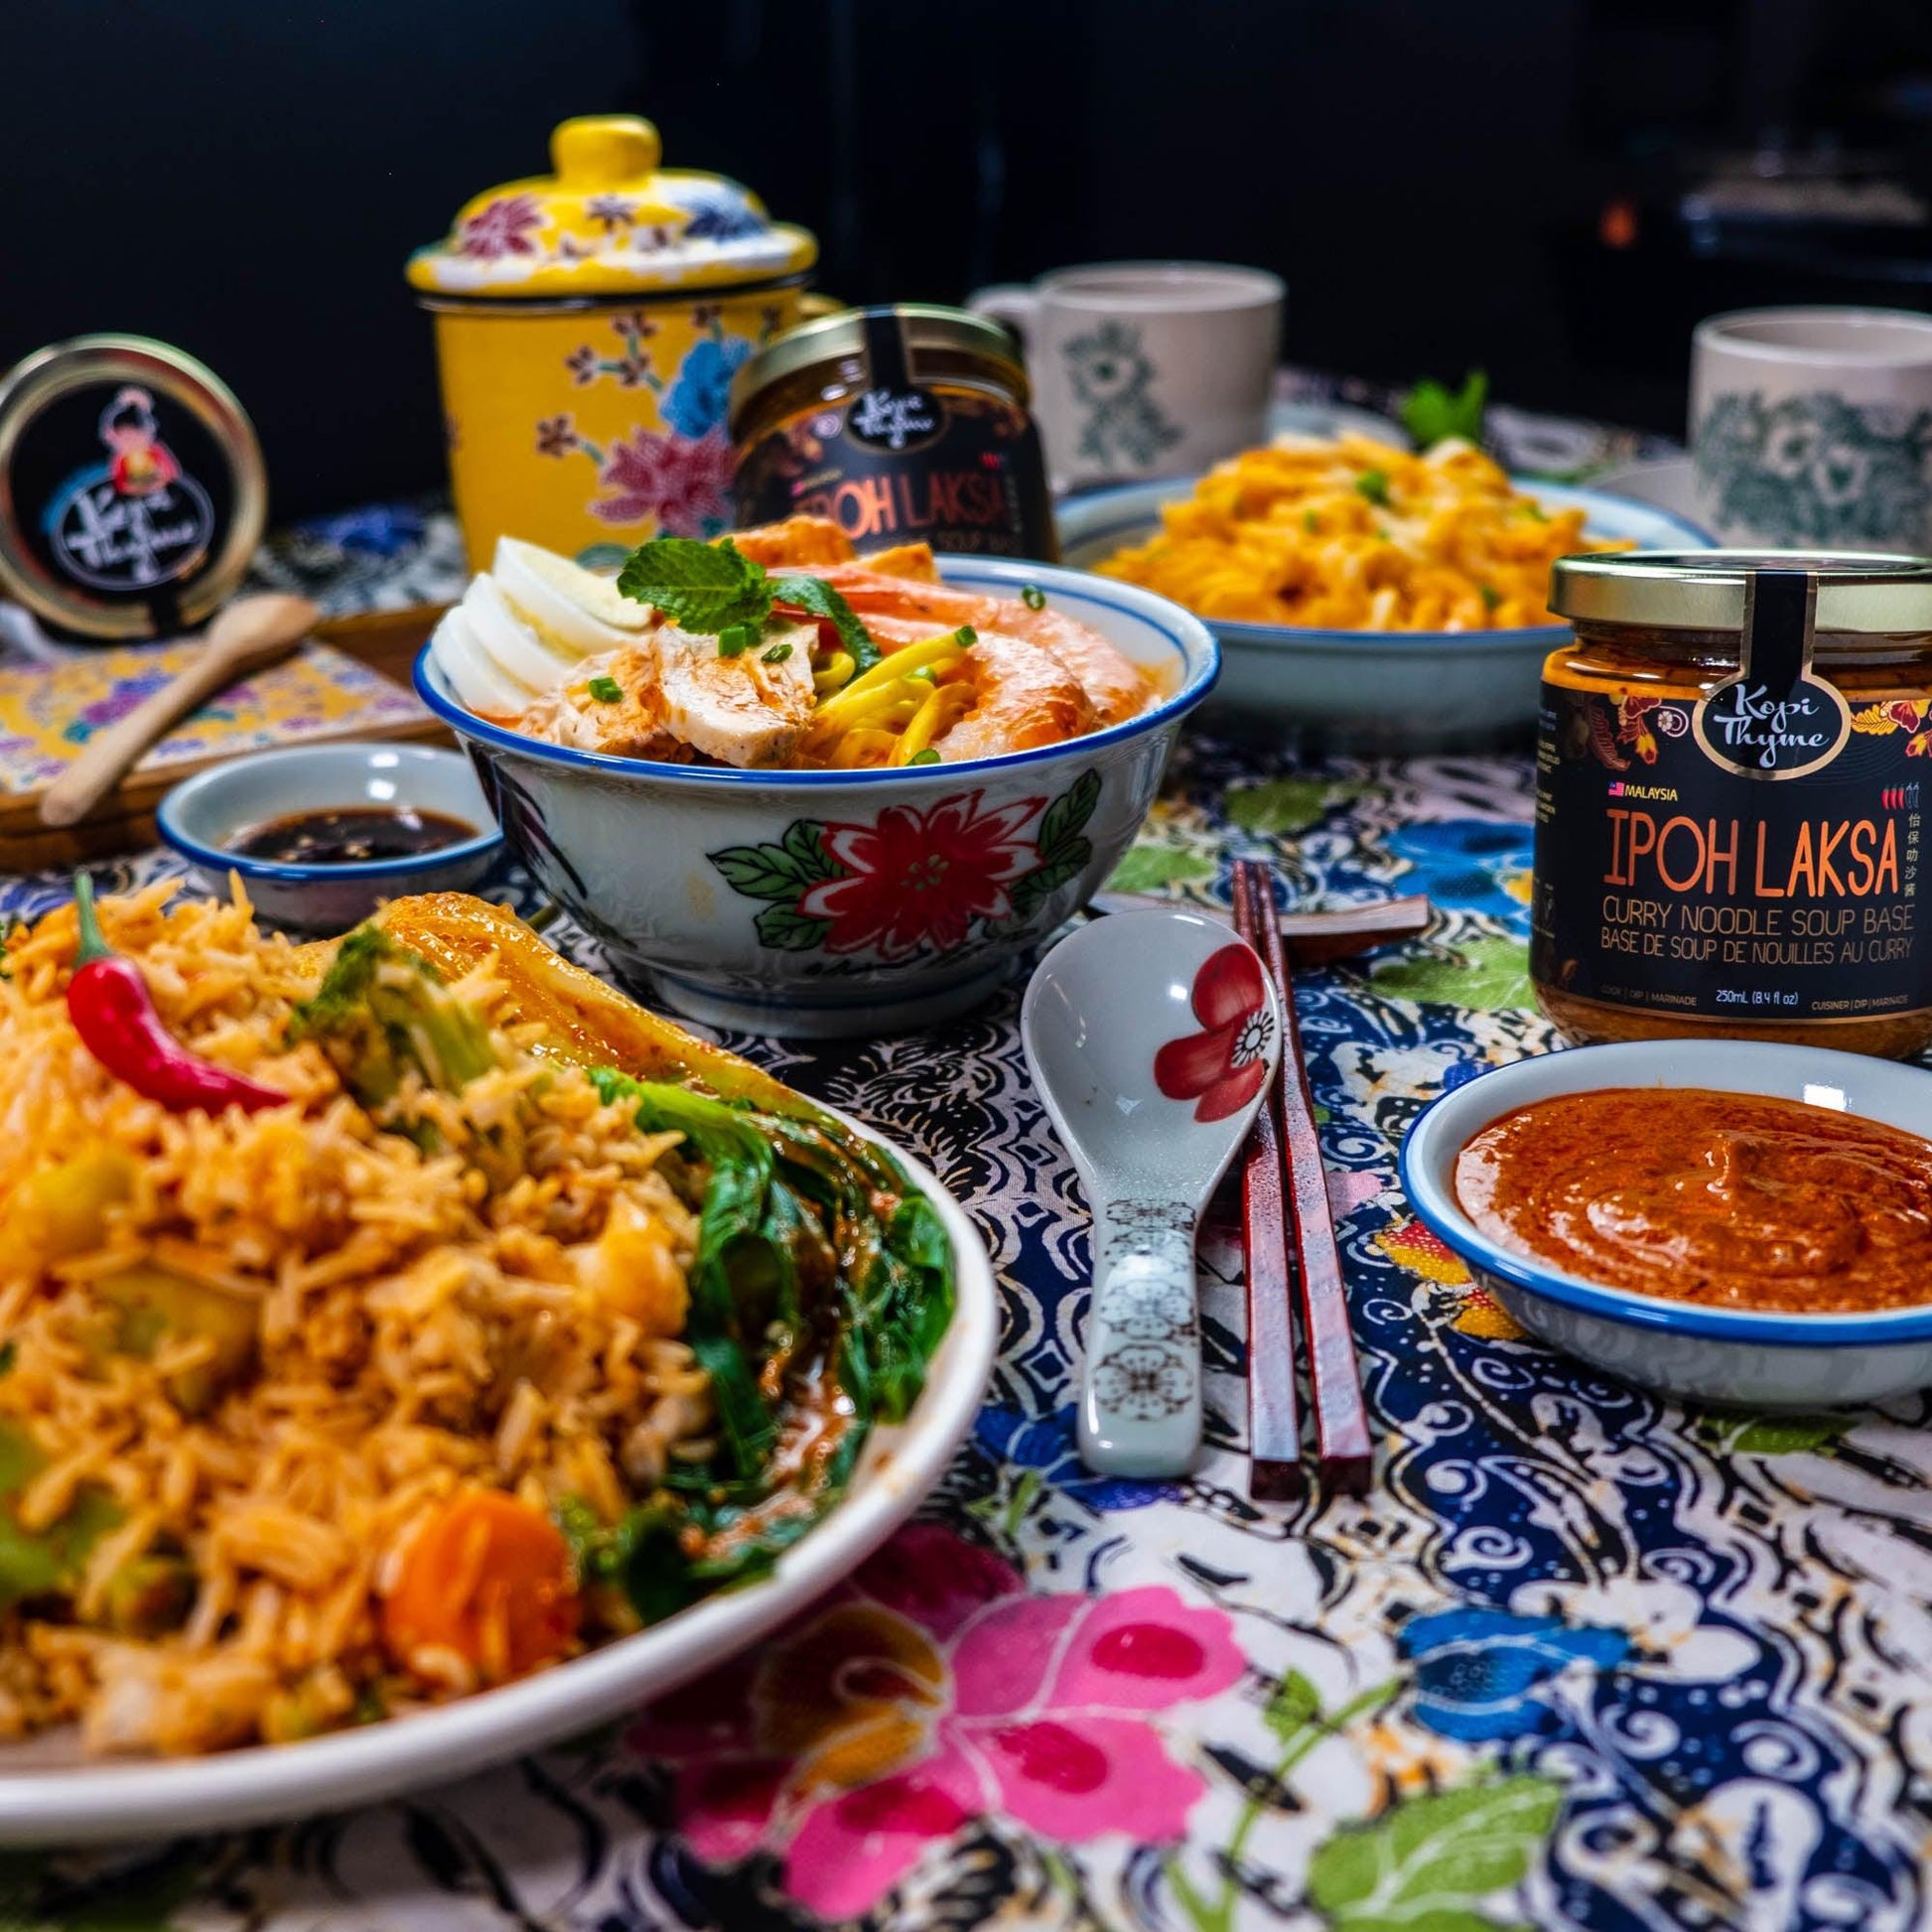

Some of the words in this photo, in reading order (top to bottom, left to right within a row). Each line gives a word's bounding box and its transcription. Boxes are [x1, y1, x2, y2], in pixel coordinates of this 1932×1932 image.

[1734, 684, 1820, 734] Kopi
[1713, 715, 1830, 768] Thyme
[1624, 785, 1678, 801] MALAYSIA
[1602, 809, 1738, 896] IPOH
[1754, 818, 1898, 897] LAKSA
[1602, 896, 1673, 928] CURRY
[1681, 904, 1783, 935] NOODLE
[1791, 909, 1856, 936] SOUP
[1863, 903, 1915, 934] BASE
[1600, 926, 1640, 954] BASE
[1643, 933, 1666, 957] DE
[1670, 936, 1717, 961] SOUP
[1724, 940, 1747, 963] DE
[1752, 941, 1835, 965] NOUILLES
[1840, 941, 1863, 964] AU
[1867, 937, 1914, 962] CURRY
[1651, 992, 1697, 1007] MARINADE
[1716, 990, 1748, 1004] 250mL
[1752, 991, 1770, 1005] (8.4
[1773, 991, 1780, 1005] fl
[1783, 992, 1799, 1005] oz)
[1811, 1000, 1850, 1011] CUISINER
[1854, 999, 1867, 1010] DIP
[1872, 995, 1909, 1008] MARINADE
